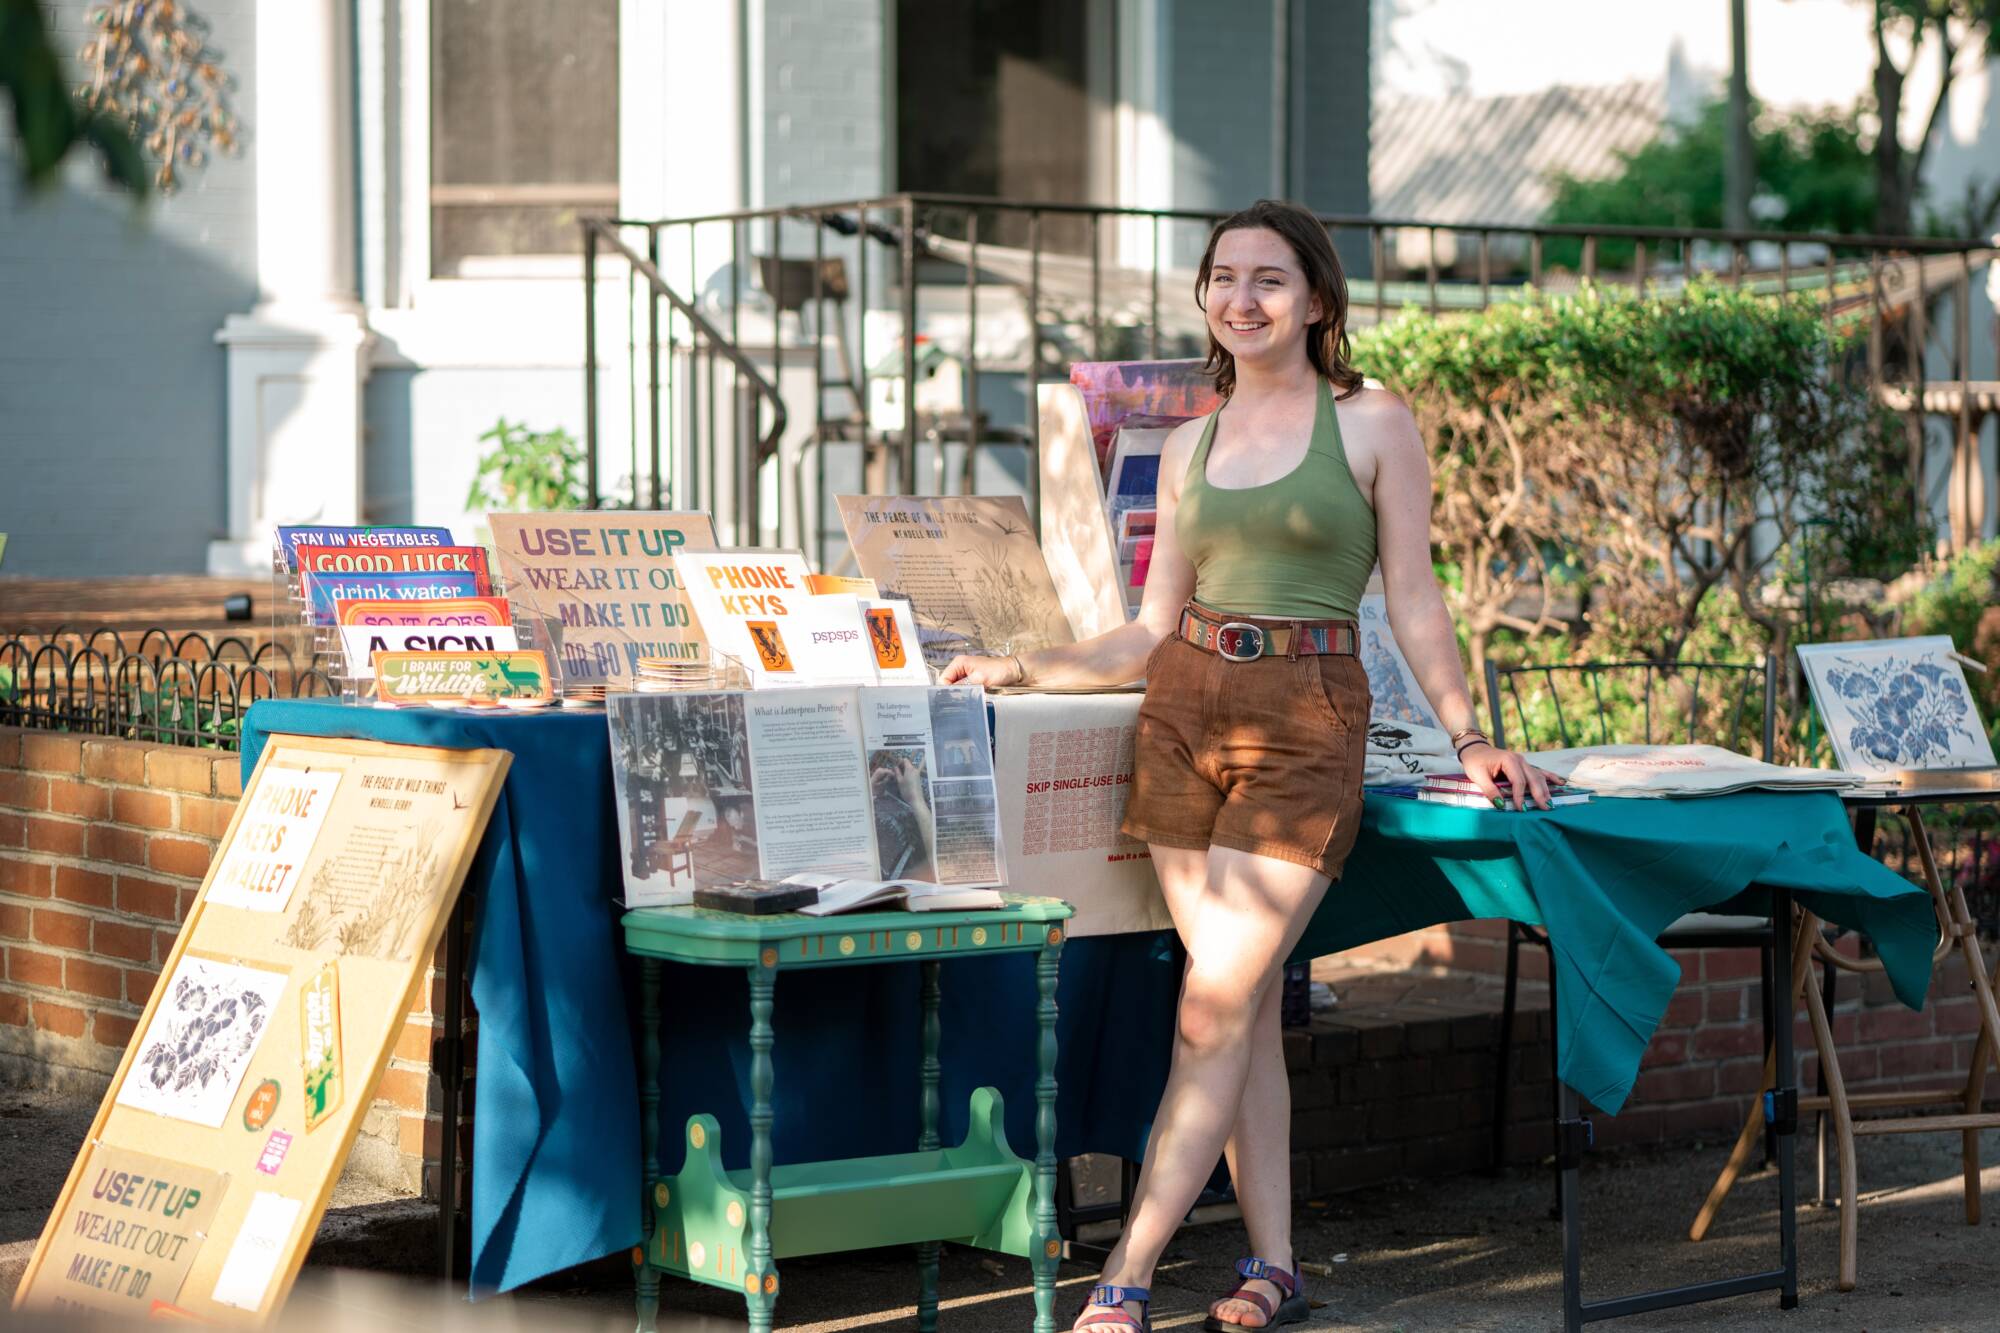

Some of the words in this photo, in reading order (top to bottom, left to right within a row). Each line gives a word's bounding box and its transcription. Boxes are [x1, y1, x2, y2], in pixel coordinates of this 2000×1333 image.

[864, 512, 881, 524] THE
[883, 511, 910, 524] PEACE
[911, 511, 921, 524] OF
[290, 533, 324, 546] STAY
[330, 533, 346, 546] IN
[349, 533, 440, 546] VEGETABLES
[519, 528, 596, 556] USE
[599, 529, 630, 556] IT
[638, 529, 686, 556] UP
[893, 529, 925, 539] WENDELL
[317, 554, 394, 572] GOOD
[401, 554, 471, 572] LUCK
[523, 568, 614, 591] WEAR
[614, 568, 640, 591] IT
[648, 568, 686, 591] OU
[706, 566, 795, 589] PHONE
[331, 584, 391, 600] drink
[394, 584, 462, 599] water
[558, 603, 625, 627] MAKE
[631, 603, 651, 627] IT
[660, 604, 690, 627] DO
[720, 595, 788, 616] KEYS
[811, 629, 859, 645] pspsps
[367, 636, 390, 667] A
[564, 643, 593, 677] OR
[594, 642, 621, 677] DO
[402, 661, 407, 673] I
[409, 661, 447, 673] BRAKE
[451, 661, 472, 673] FOR
[385, 671, 487, 698] Wildlife
[754, 706, 773, 717] What
[774, 706, 780, 715] is
[781, 704, 816, 717] Letterpress
[817, 702, 848, 714] Printing?
[361, 775, 374, 788] THE
[375, 776, 394, 790] PEACE
[396, 777, 404, 790] OF
[405, 779, 421, 793] WILD
[423, 781, 447, 795] THINGS
[1026, 782, 1051, 794] SKIP
[1052, 775, 1114, 791] SINGLE-USE
[1115, 773, 1135, 786] BAG
[370, 797, 391, 810] WENDELL
[1107, 854, 1124, 862] Make
[92, 1168, 144, 1208] USE
[137, 1178, 168, 1212] IT
[162, 1188, 201, 1219] UP
[73, 1210, 126, 1247] WEAR
[122, 1222, 147, 1251] IT
[144, 1229, 188, 1261] OUT
[66, 1253, 112, 1289] MAKE
[108, 1263, 129, 1291] IT
[127, 1269, 152, 1299] DO
